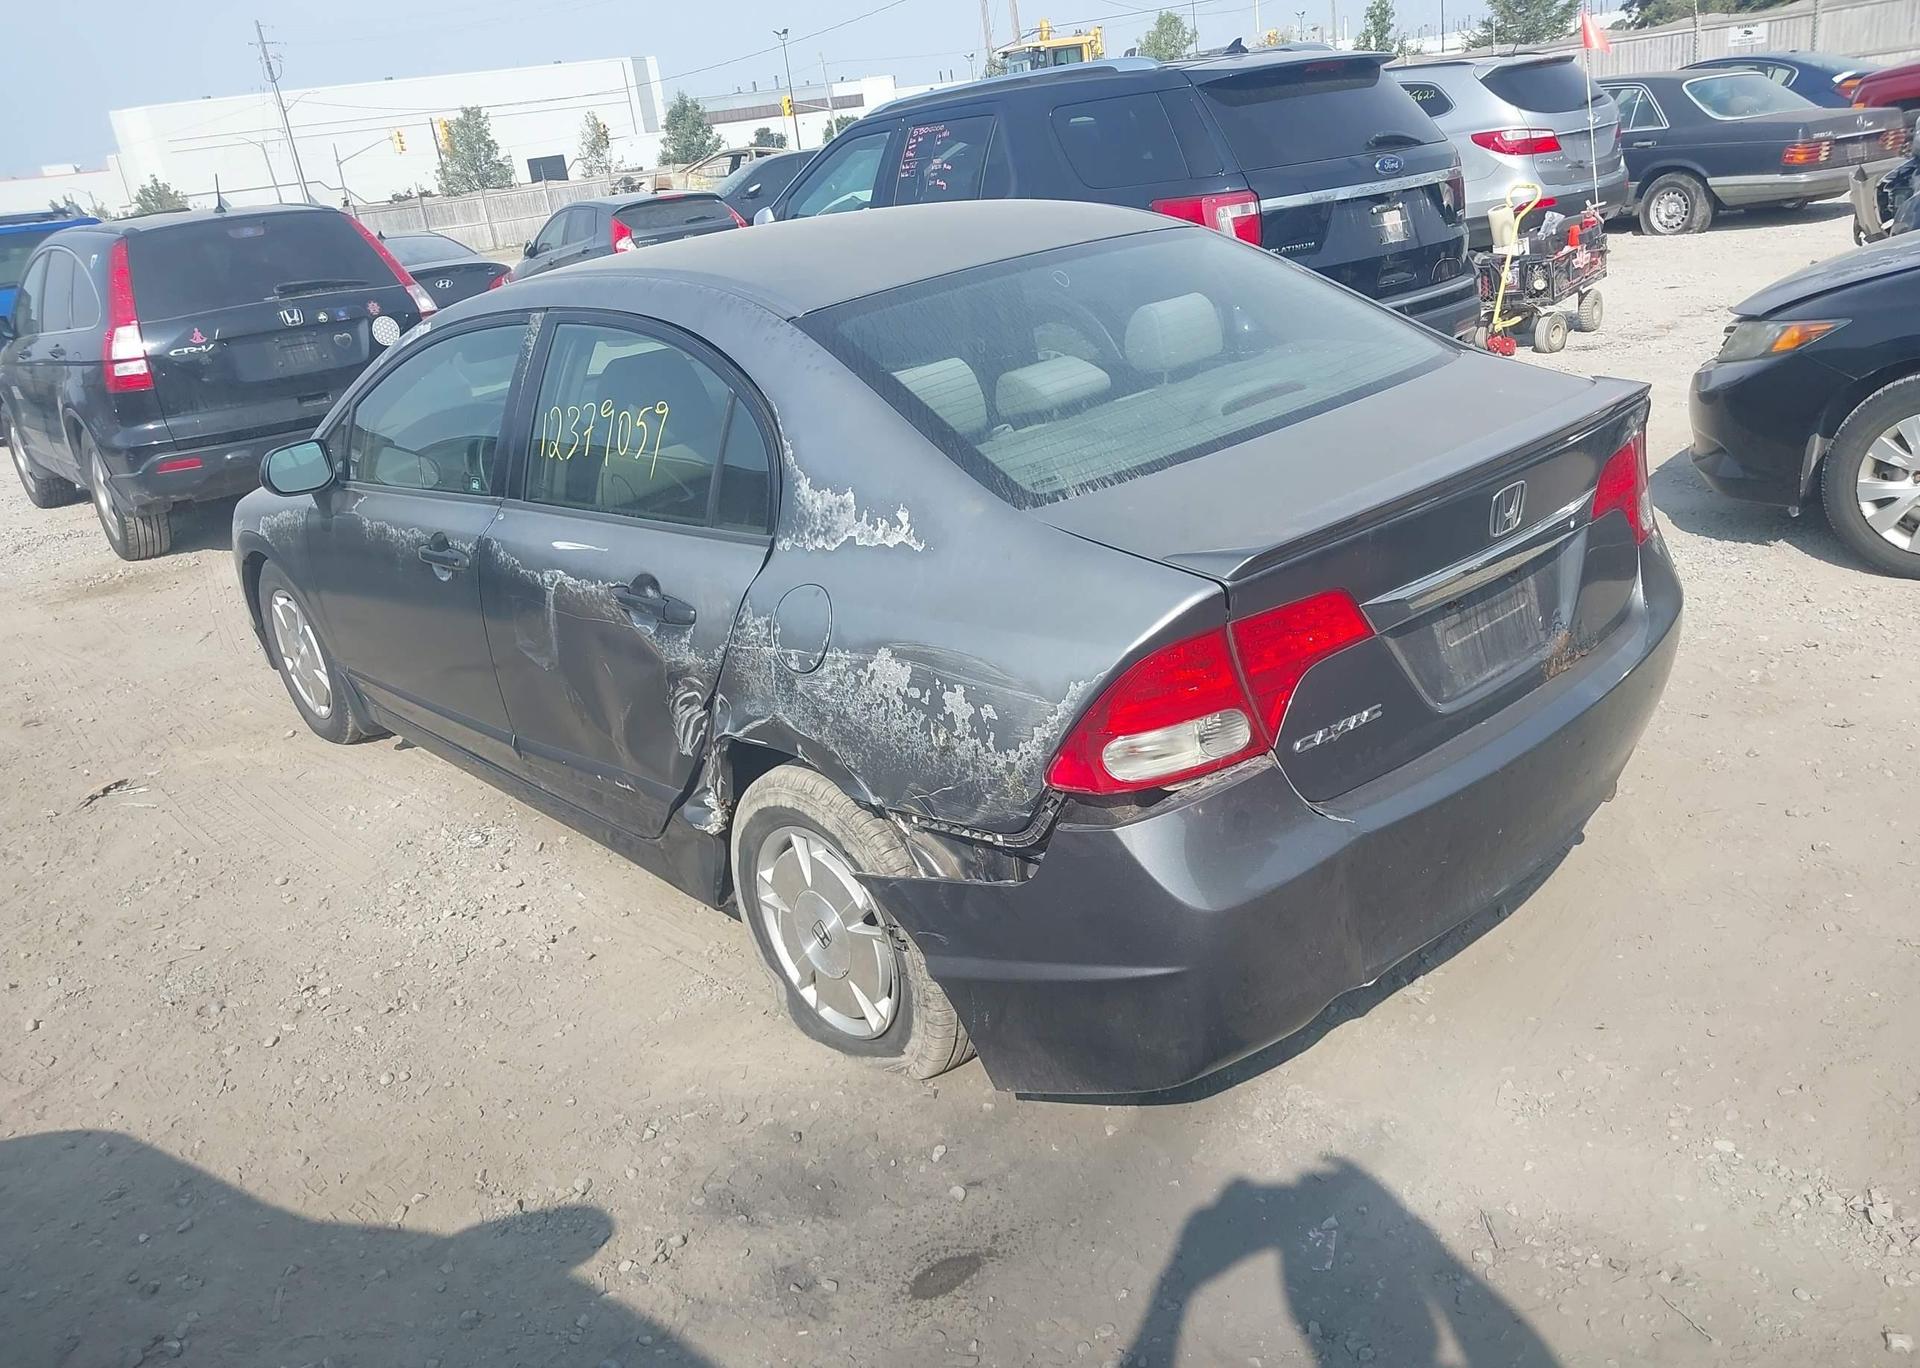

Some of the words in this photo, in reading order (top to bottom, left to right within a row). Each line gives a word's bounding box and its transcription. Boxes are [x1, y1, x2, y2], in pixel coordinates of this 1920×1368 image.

[1406, 89, 1435, 101] 5622
[1384, 158, 1399, 170] Ford
[1269, 241, 1316, 254] PLATINUM
[169, 343, 215, 357] CR-V
[540, 399, 670, 480] 12379059
[1293, 703, 1384, 755] CIVIC
